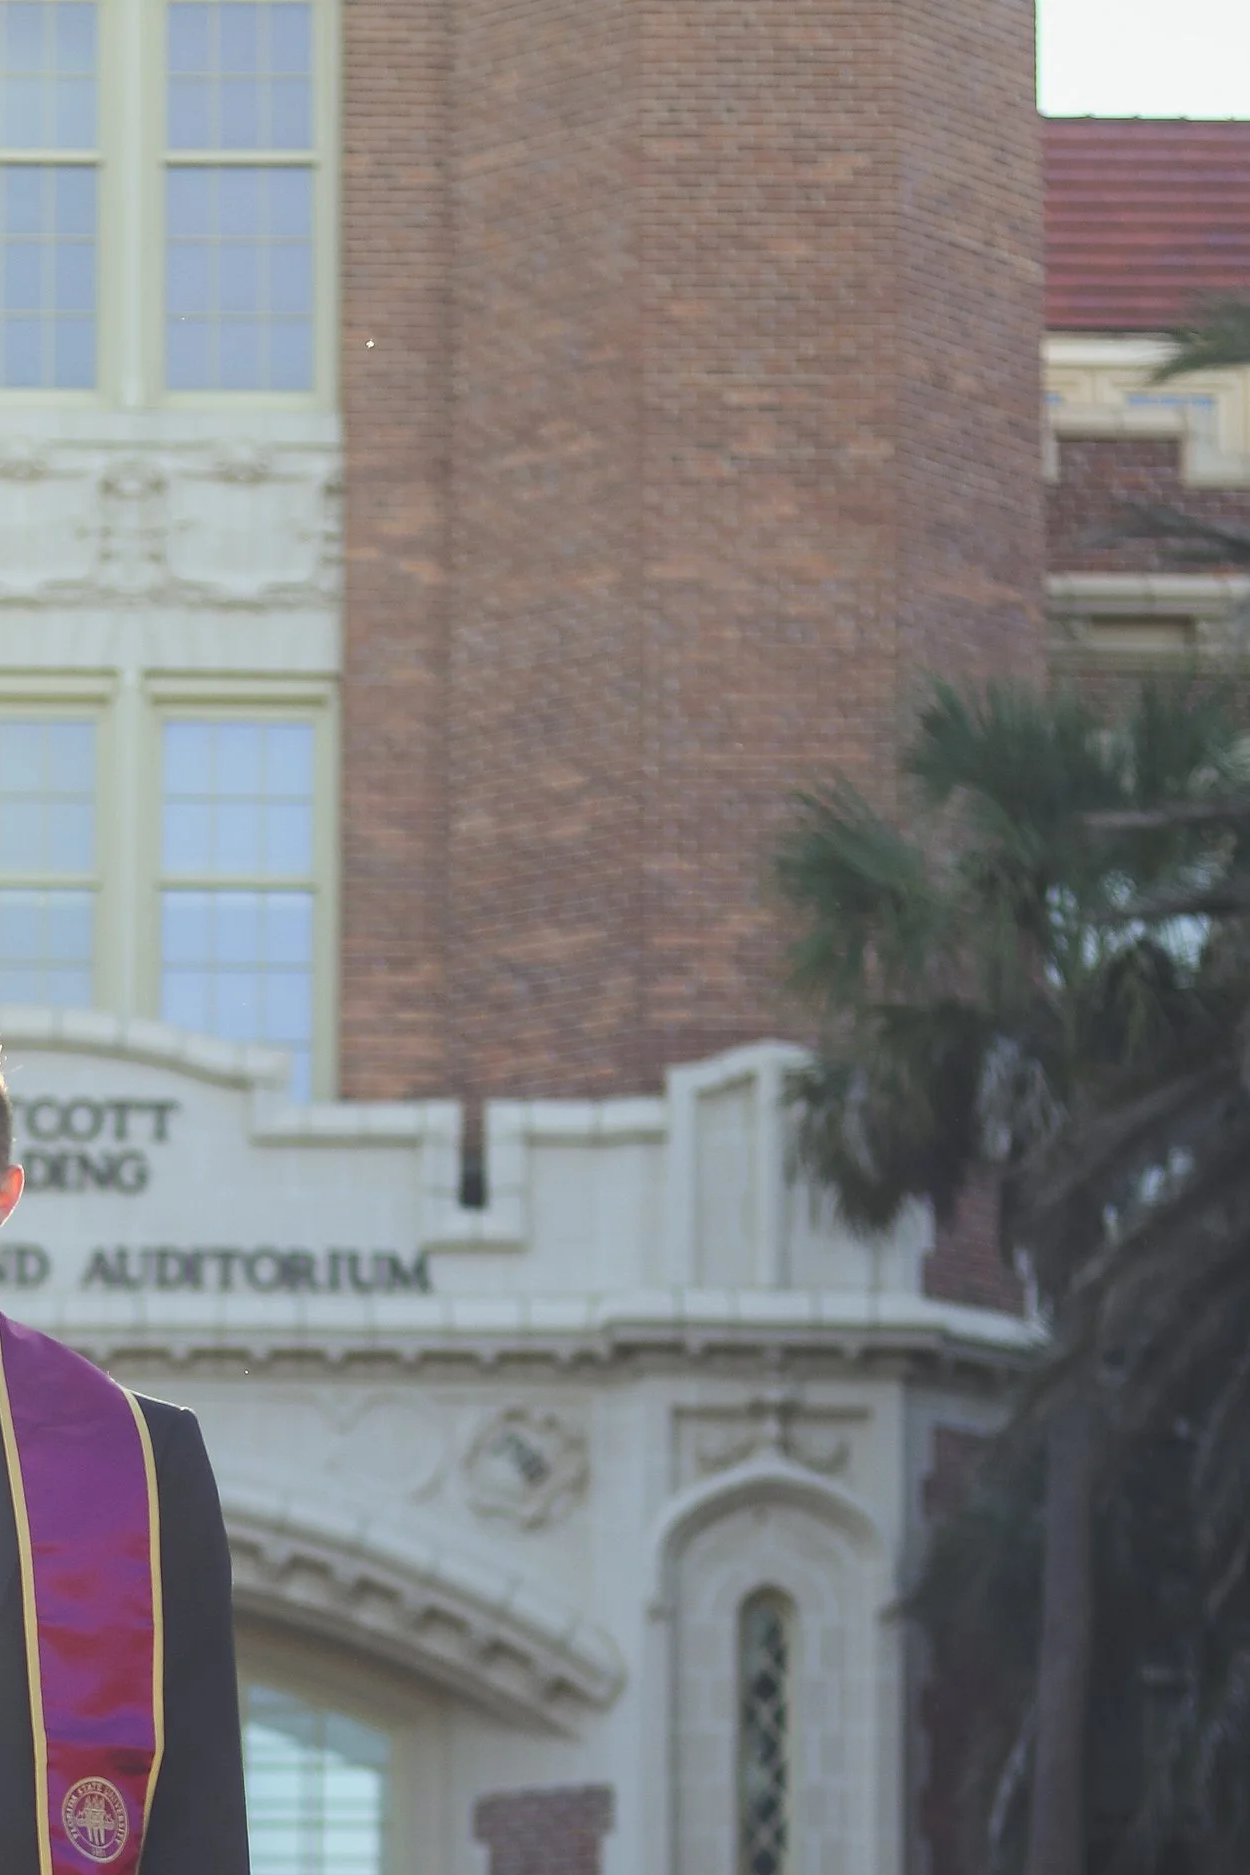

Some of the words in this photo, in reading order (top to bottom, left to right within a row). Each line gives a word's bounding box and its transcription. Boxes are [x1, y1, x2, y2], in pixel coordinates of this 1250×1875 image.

[12, 1096, 182, 1142] COTT
[21, 1149, 152, 1196] DING
[80, 1243, 435, 1294] AUDITORIUM
